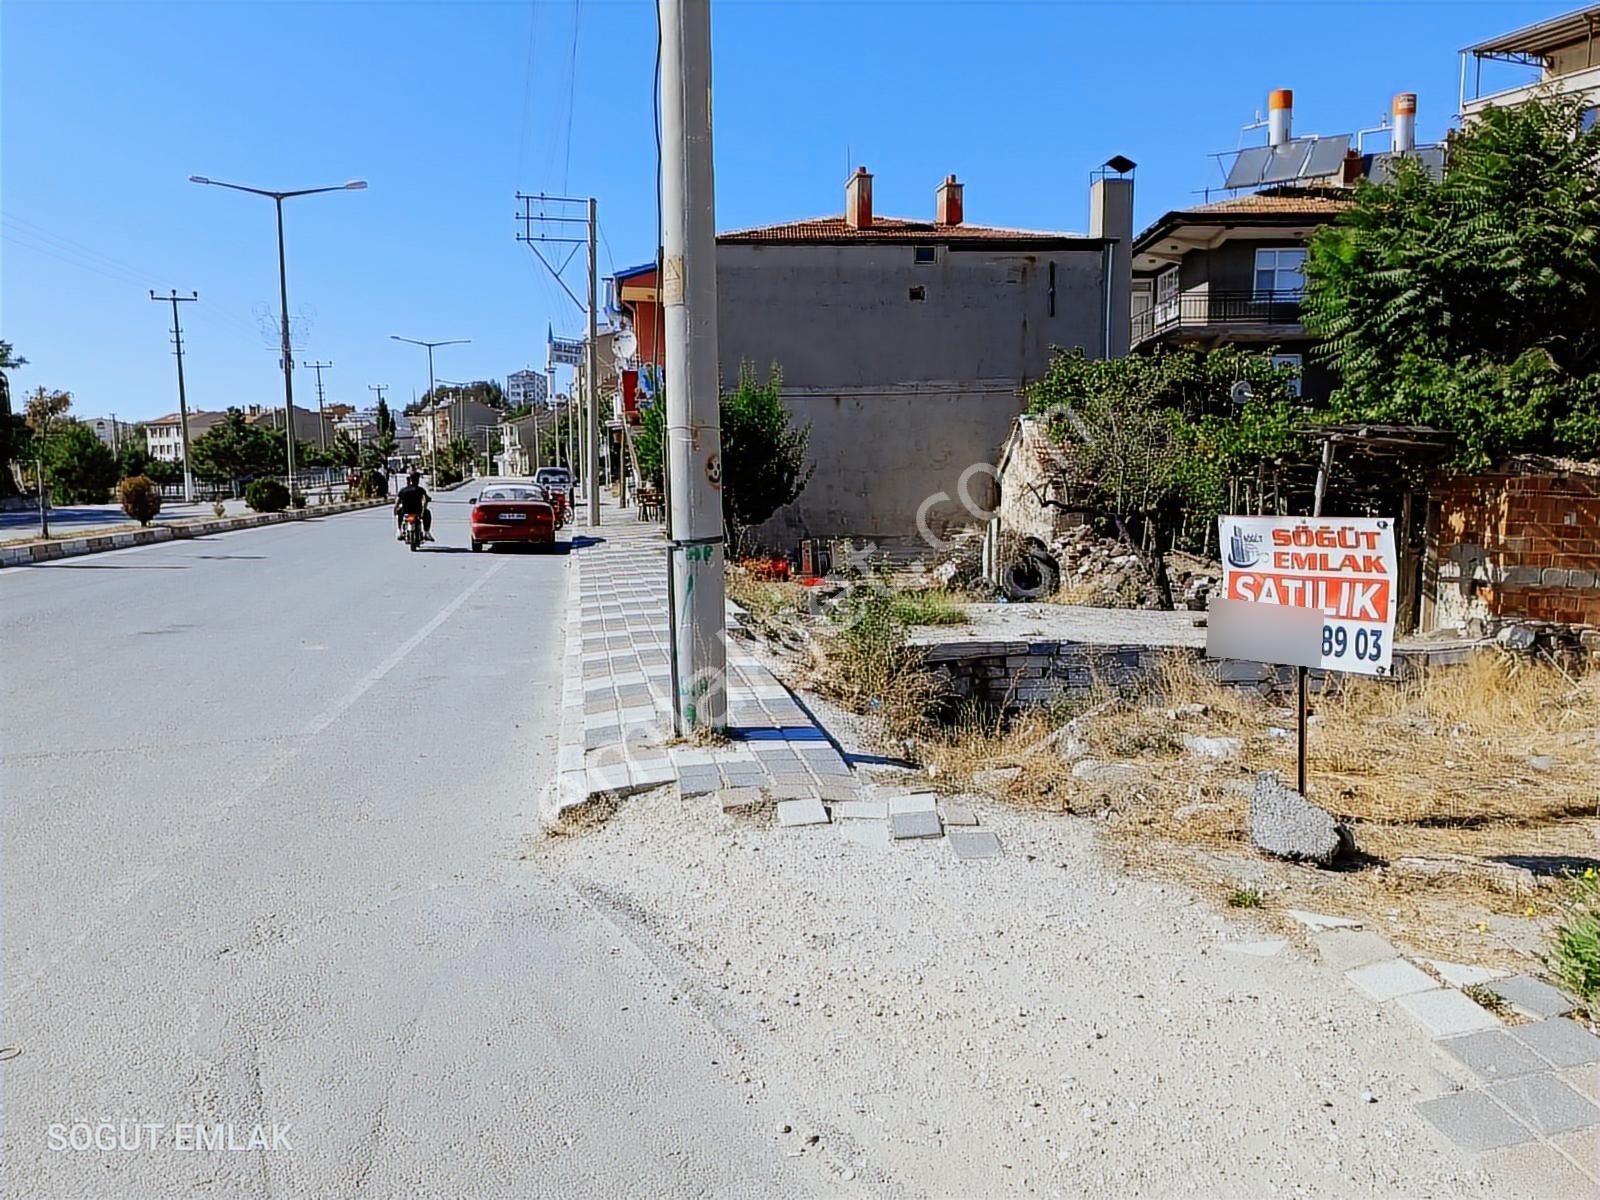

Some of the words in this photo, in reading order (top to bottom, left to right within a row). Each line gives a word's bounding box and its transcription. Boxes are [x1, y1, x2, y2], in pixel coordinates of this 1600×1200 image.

[1272, 525, 1381, 550] SÖĞÜT
[1273, 552, 1387, 573] EMLAK
[1355, 628, 1382, 661] 03
